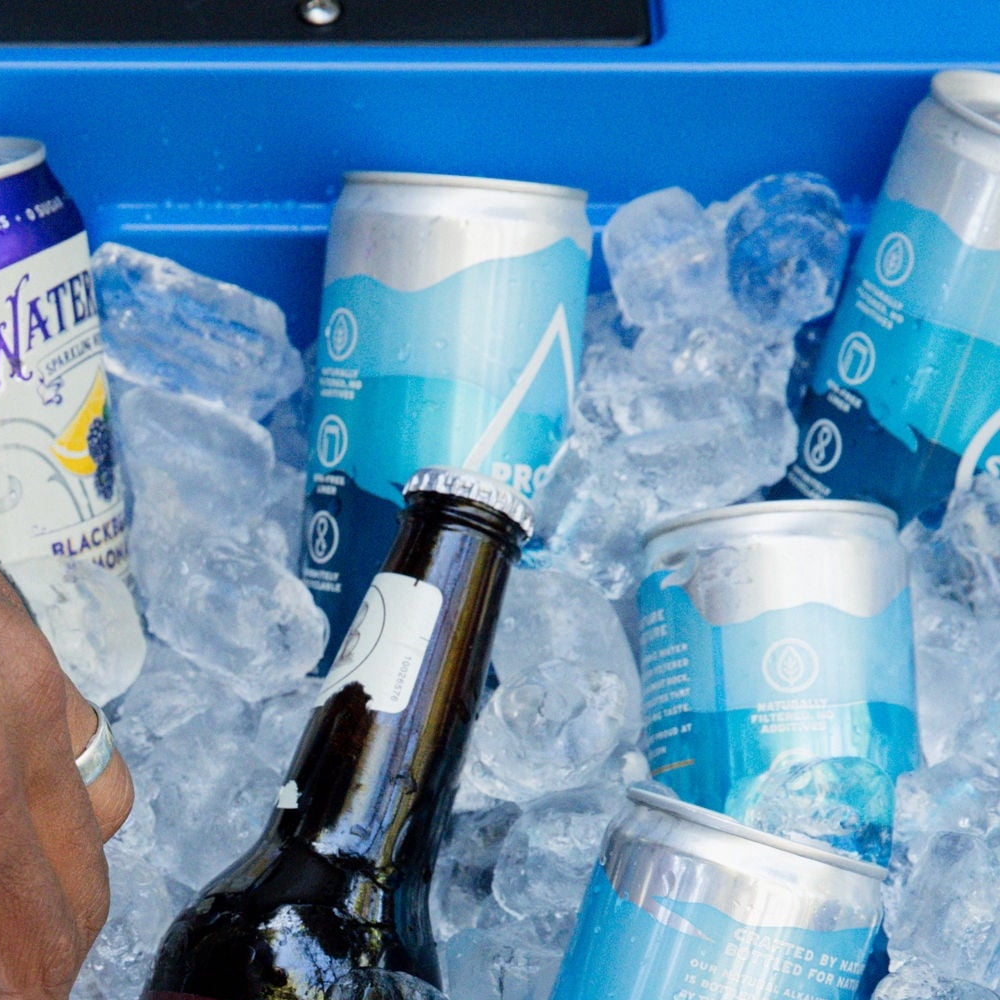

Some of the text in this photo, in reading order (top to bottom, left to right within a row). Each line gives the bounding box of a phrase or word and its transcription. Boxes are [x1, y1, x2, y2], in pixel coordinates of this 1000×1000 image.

[690, 958, 718, 974] OUR
[724, 943, 834, 985] BOTTLED FOR
[733, 927, 837, 968] CRAFTED BY
